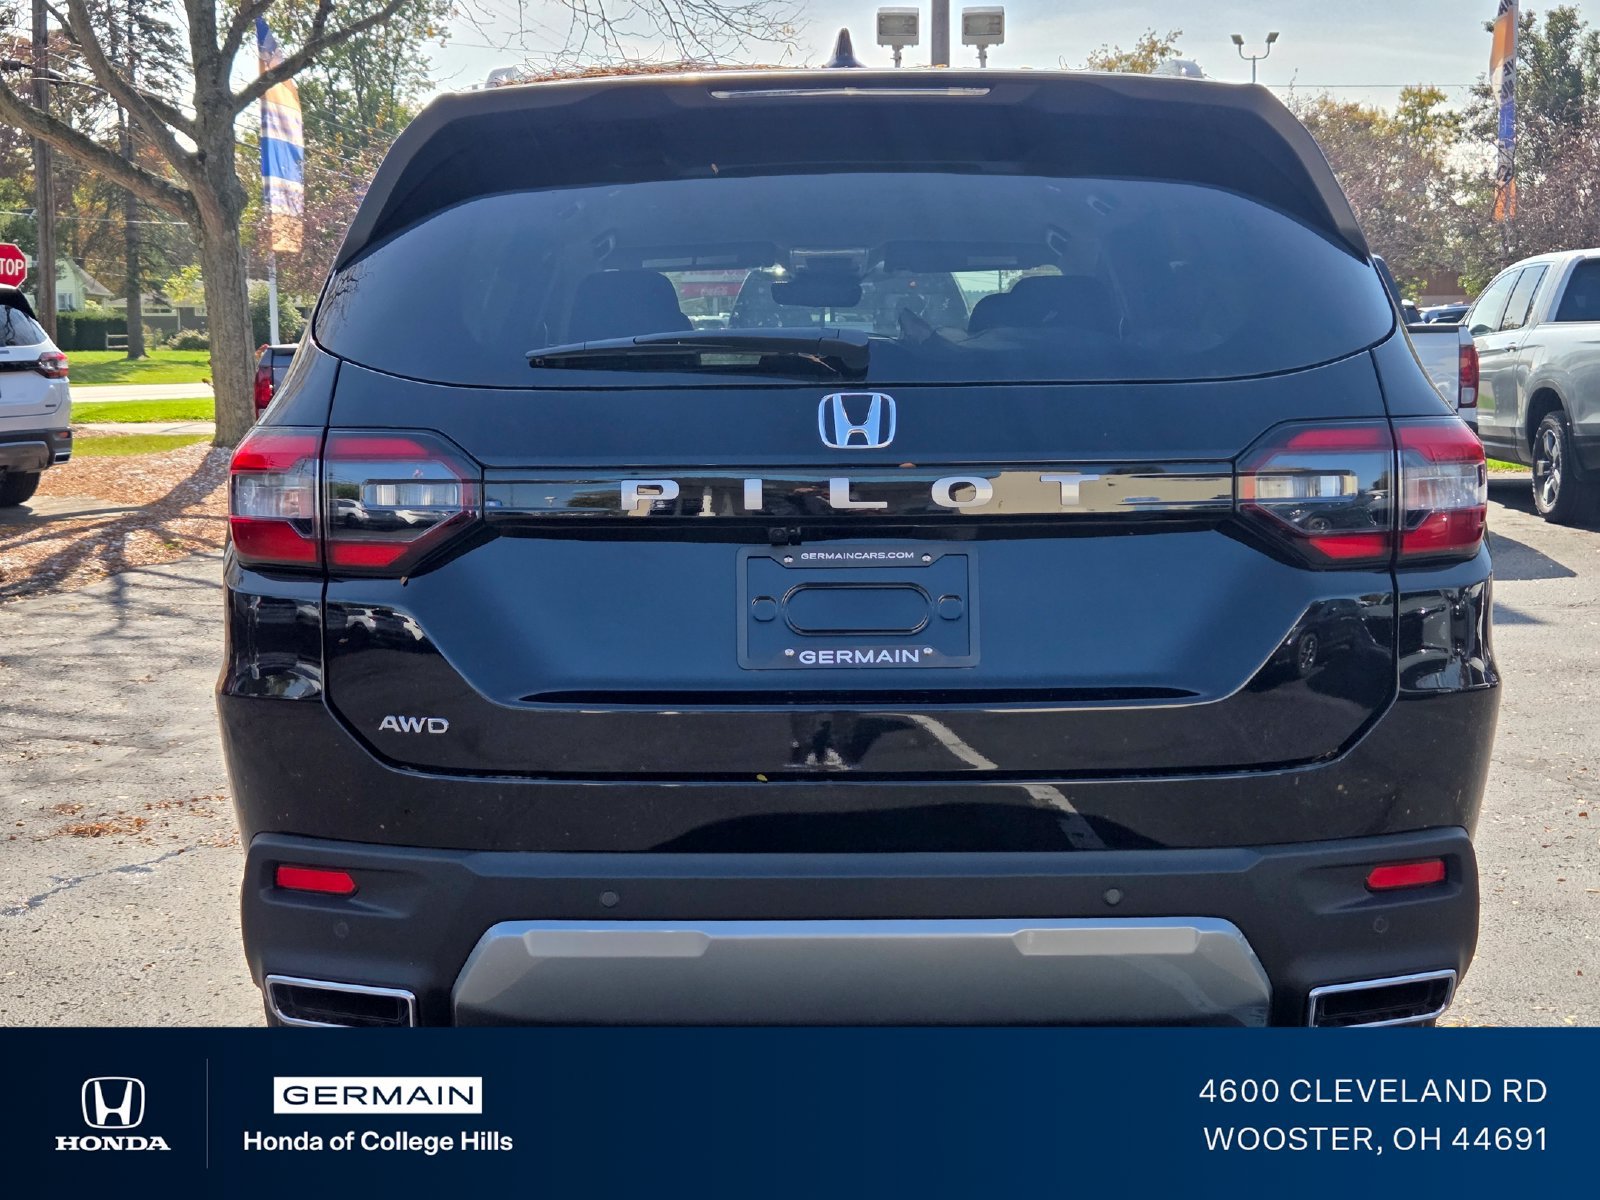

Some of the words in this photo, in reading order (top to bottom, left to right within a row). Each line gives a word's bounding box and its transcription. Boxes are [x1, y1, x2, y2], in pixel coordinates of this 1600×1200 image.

[0, 257, 24, 276] TOP
[620, 473, 1100, 511] PILOT
[800, 551, 915, 560] GERMAINCARS.COM
[799, 648, 920, 665] GERMAIN
[378, 715, 450, 734] AWD
